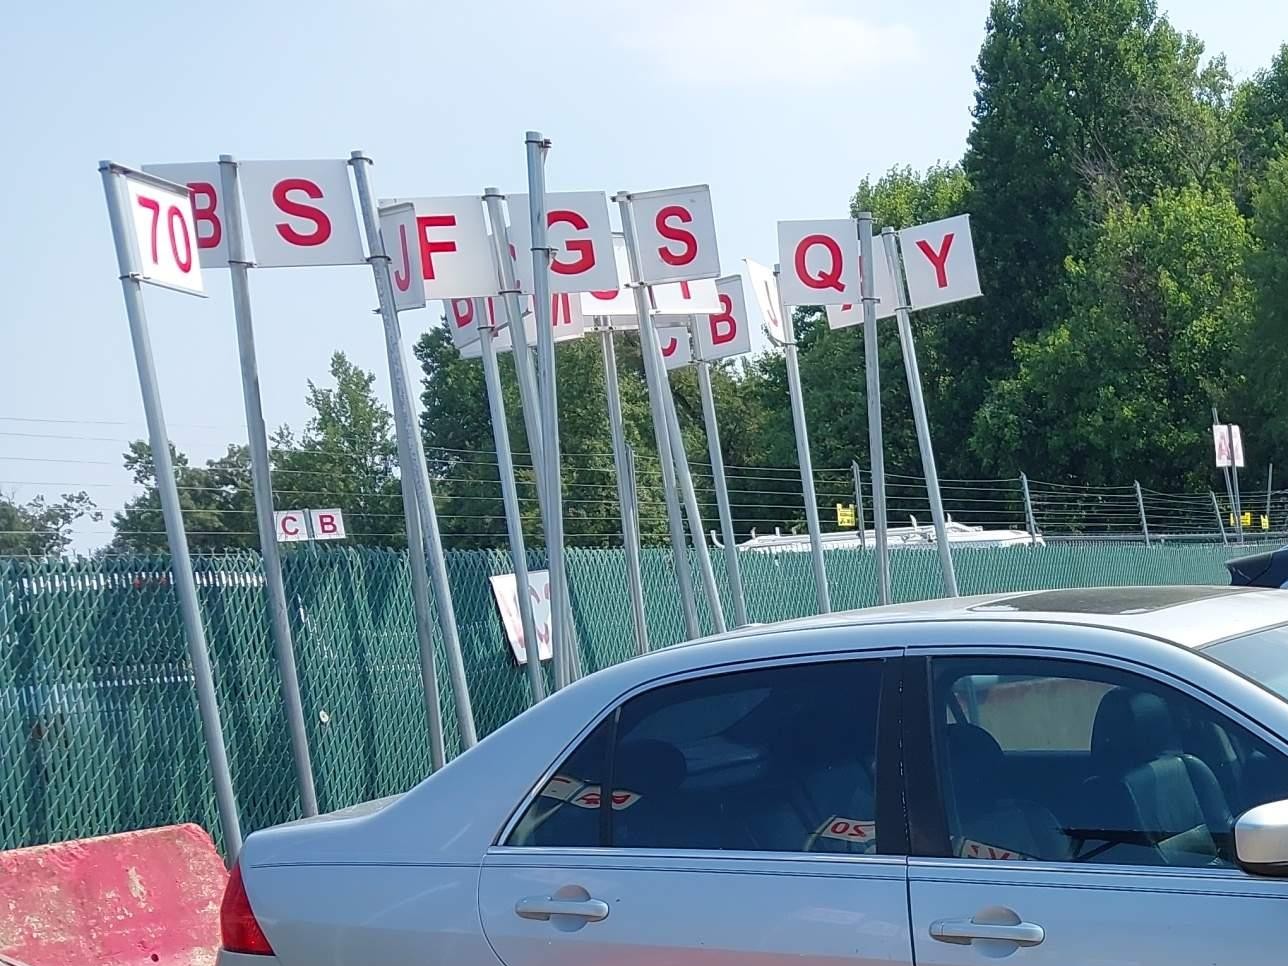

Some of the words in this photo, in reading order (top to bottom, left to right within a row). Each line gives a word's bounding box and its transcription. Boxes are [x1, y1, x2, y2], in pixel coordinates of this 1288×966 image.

[136, 194, 192, 273] 70
[186, 182, 222, 249] B
[272, 178, 332, 247] S
[546, 210, 596, 275] G
[655, 205, 698, 266] S
[394, 224, 410, 292] J
[416, 215, 457, 280] F
[794, 234, 846, 292] Q
[915, 233, 955, 289] Y
[709, 293, 737, 345] B
[281, 516, 299, 535] C
[319, 514, 337, 533] B
